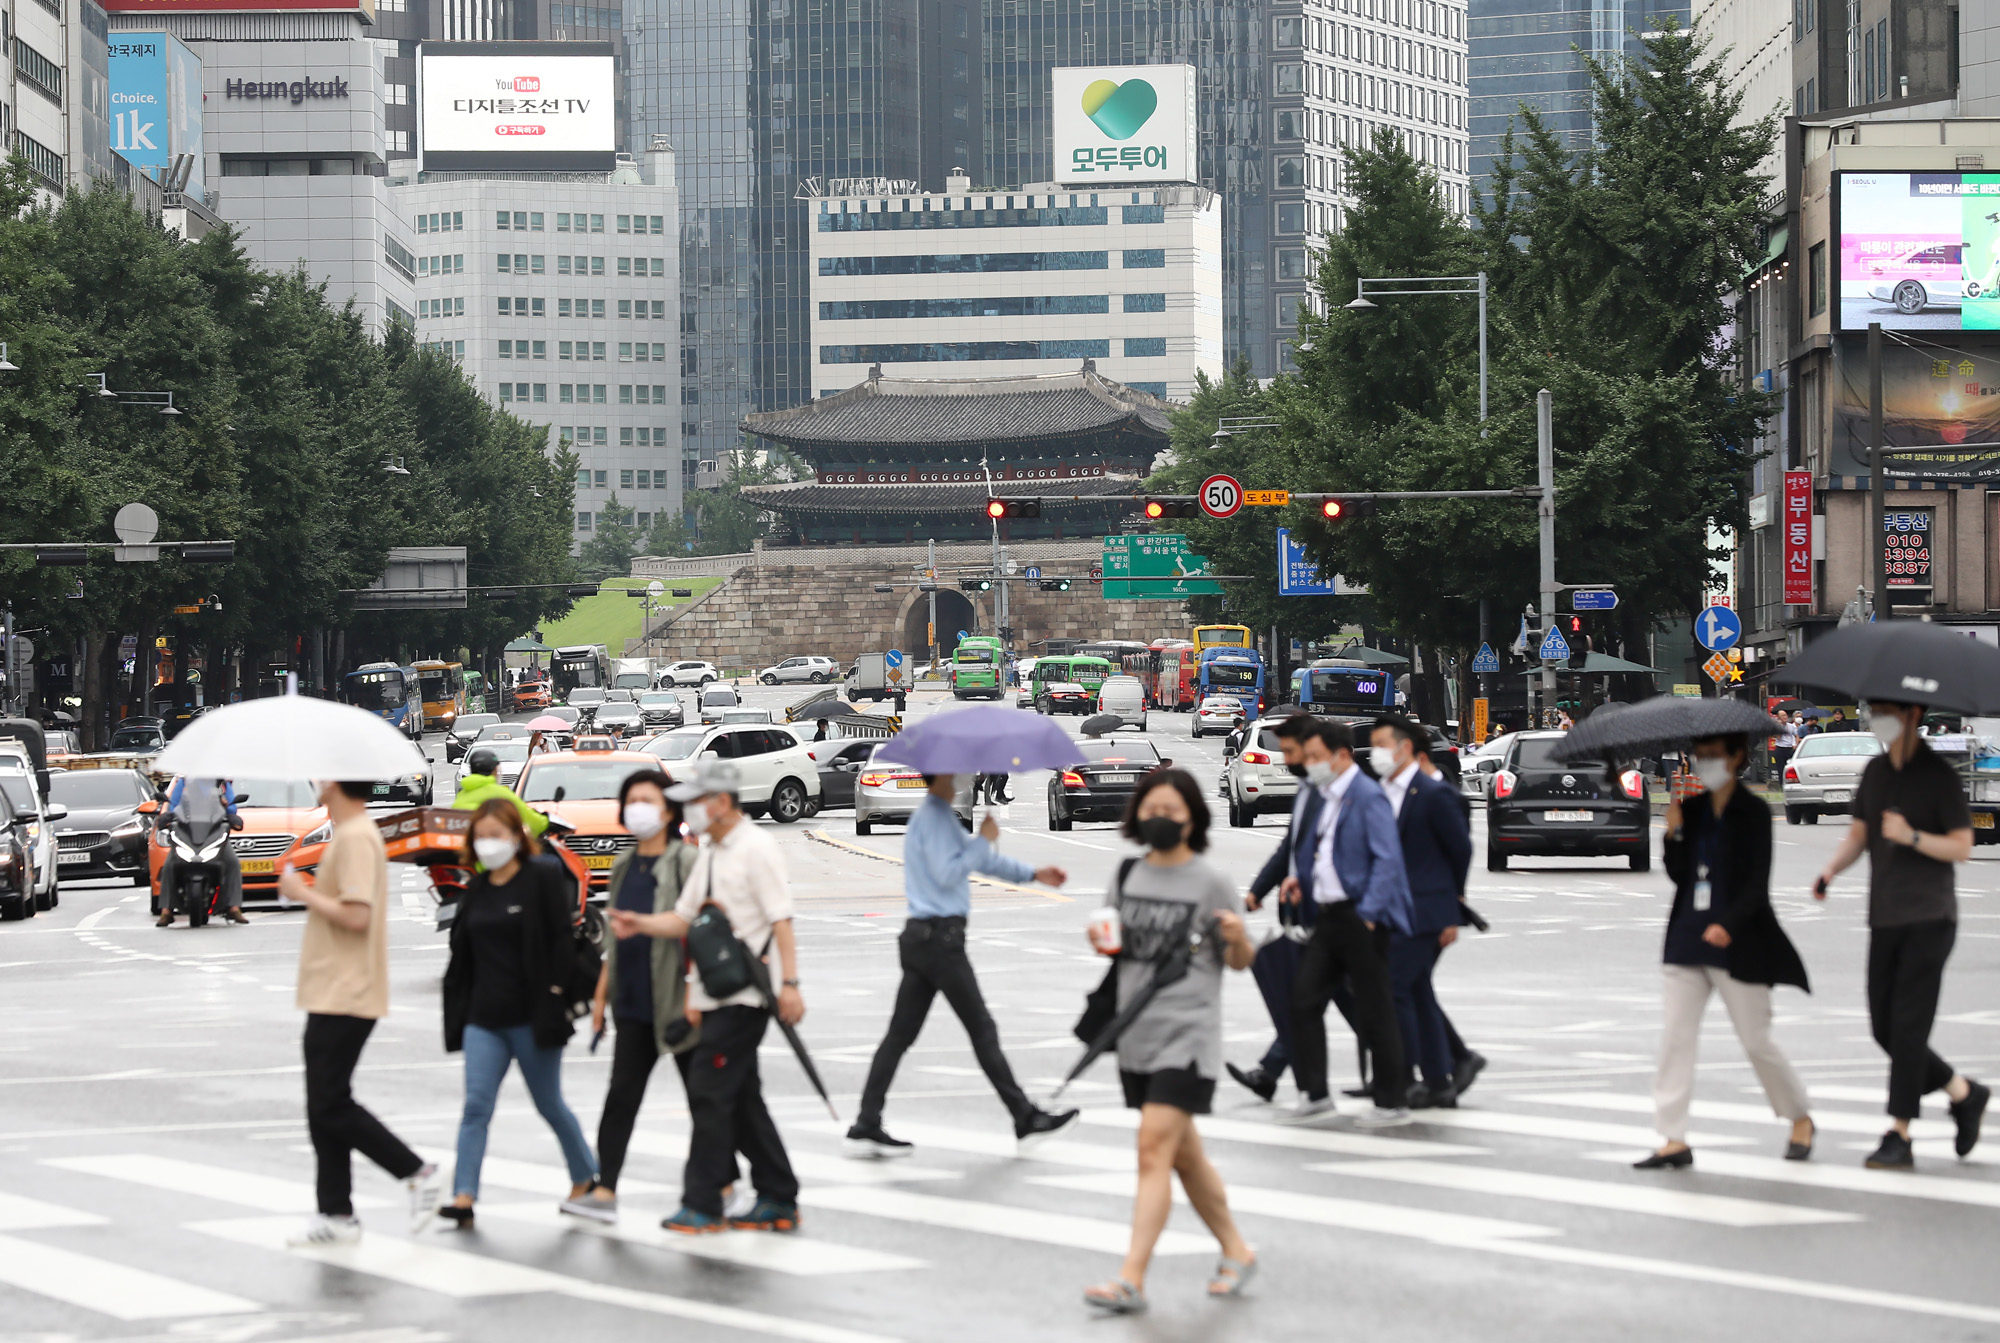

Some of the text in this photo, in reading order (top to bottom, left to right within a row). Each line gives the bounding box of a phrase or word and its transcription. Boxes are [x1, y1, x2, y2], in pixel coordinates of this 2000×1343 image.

[107, 44, 156, 57] 한국제지
[226, 75, 349, 104] Heungkuk
[495, 77, 540, 92] YouTube
[111, 92, 158, 105] Choice,
[564, 99, 591, 114] TV
[509, 125, 540, 135] 구독하기
[1071, 145, 1167, 172] 모두투어
[1786, 477, 1810, 490] 열린
[1208, 485, 1234, 508] 50
[1245, 493, 1286, 503] 도심부
[1884, 512, 1928, 531] 부동산
[1789, 495, 1809, 573] 부동산
[1146, 537, 1178, 546] 한강대교
[1886, 534, 1923, 548] 010
[1153, 546, 1178, 555] 서울역
[1290, 570, 1314, 578] 중앙차
[50, 663, 67, 677] M
[563, 662, 586, 671] 1711
[361, 673, 386, 684] 708
[1239, 672, 1253, 680] 150
[1357, 681, 1377, 693] 400
